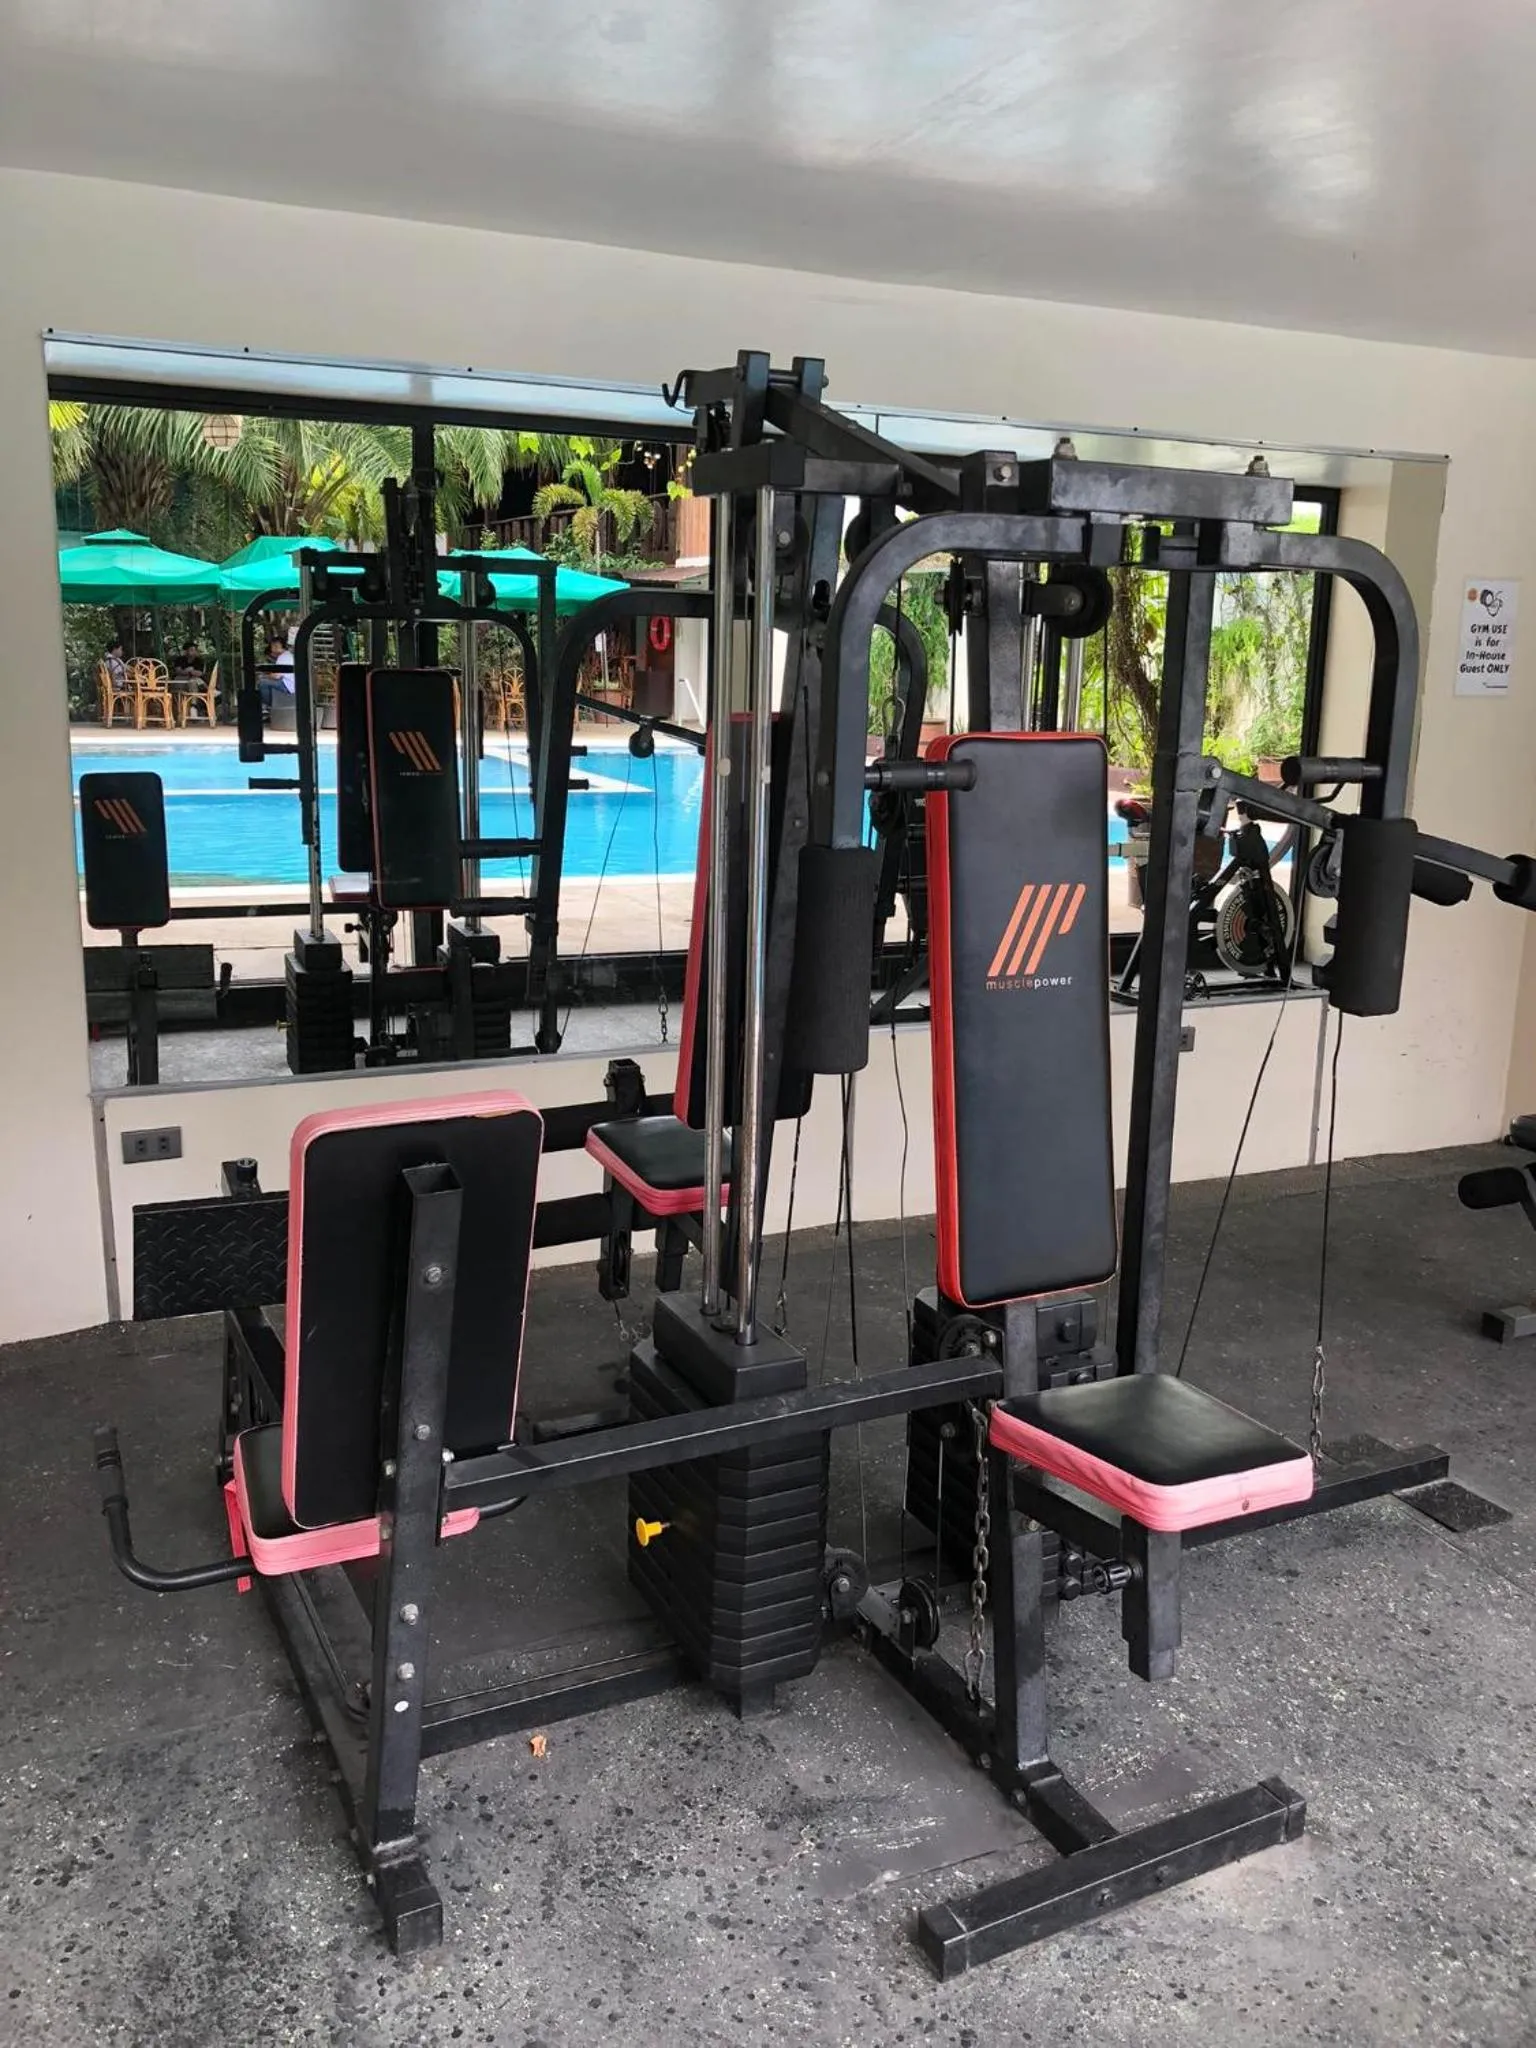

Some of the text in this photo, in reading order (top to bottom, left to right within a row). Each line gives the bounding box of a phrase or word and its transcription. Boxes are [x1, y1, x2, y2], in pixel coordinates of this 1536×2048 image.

[1470, 623, 1508, 634] GYM USE
[1475, 636, 1501, 647] is for
[1465, 650, 1506, 661] In-House
[1460, 663, 1510, 674] Guest ONLY
